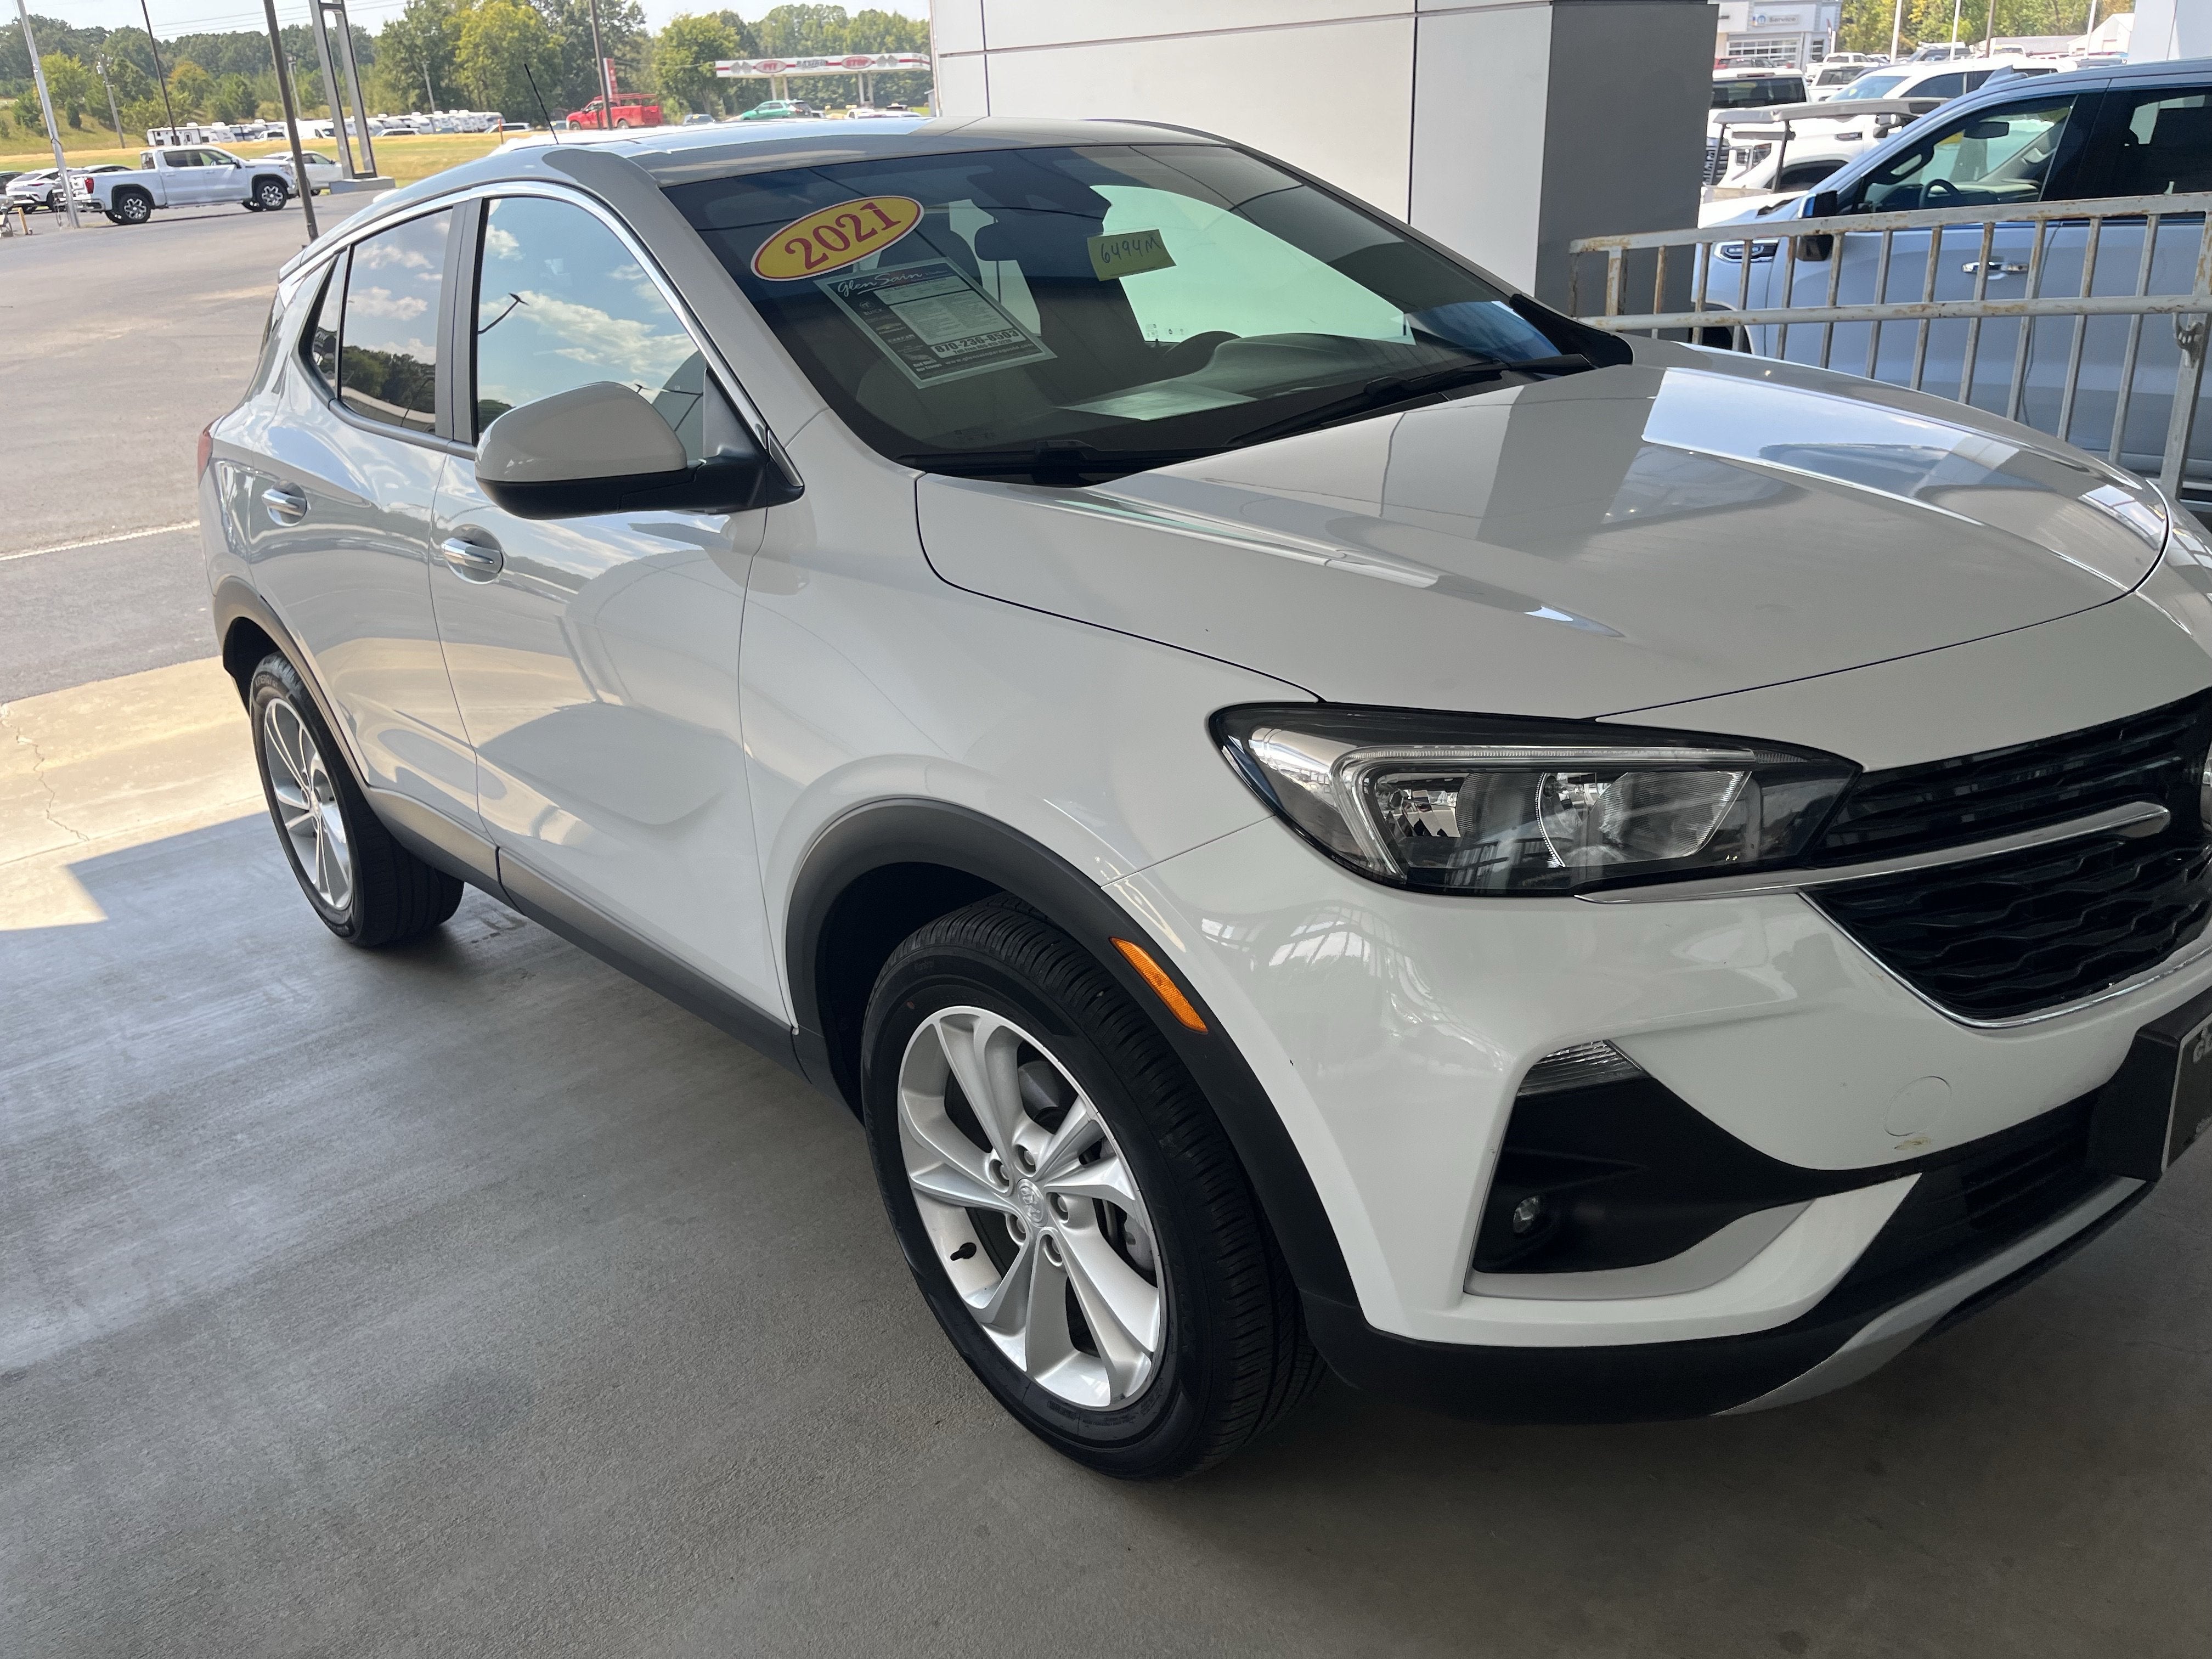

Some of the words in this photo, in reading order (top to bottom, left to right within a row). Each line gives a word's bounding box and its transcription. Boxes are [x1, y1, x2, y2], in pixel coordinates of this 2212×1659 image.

[763, 63, 778, 71] PIT
[785, 202, 901, 270] 2021
[1101, 236, 1162, 263] 6494M
[837, 280, 877, 297] Glen
[874, 273, 922, 286] Sain
[934, 330, 1019, 353] 870-236-8503
